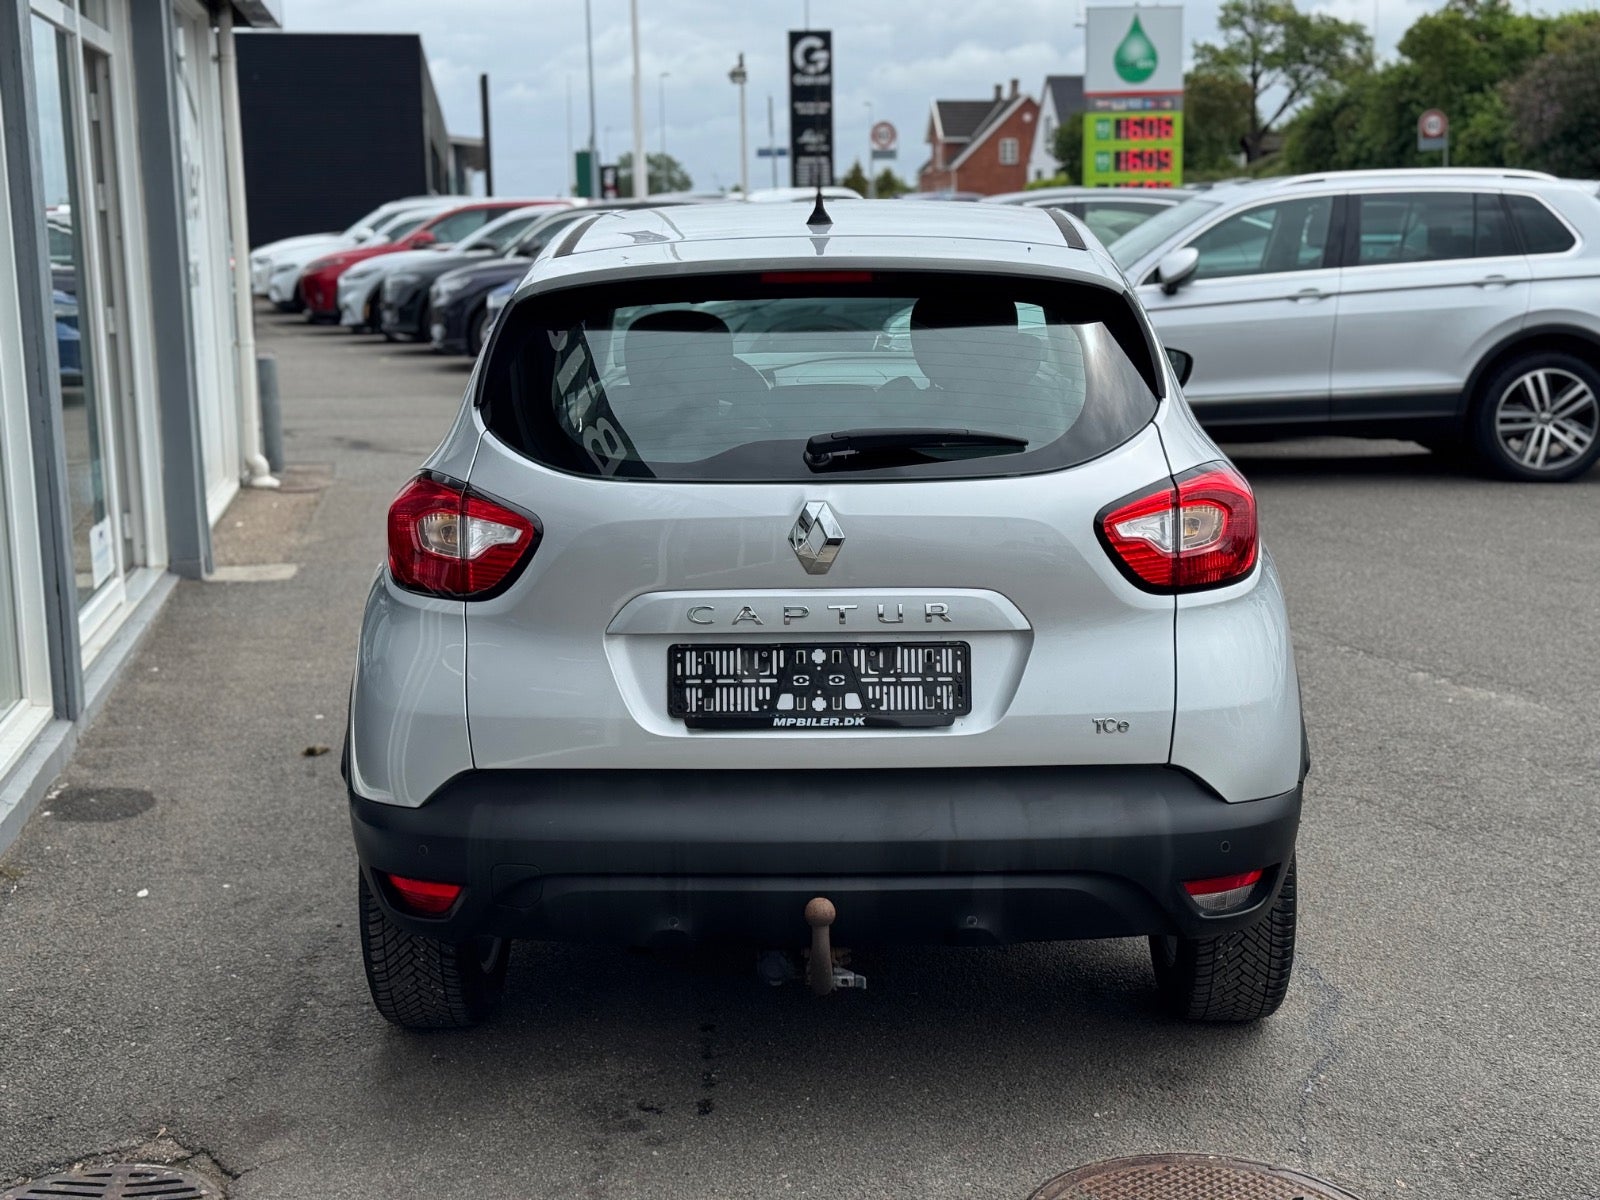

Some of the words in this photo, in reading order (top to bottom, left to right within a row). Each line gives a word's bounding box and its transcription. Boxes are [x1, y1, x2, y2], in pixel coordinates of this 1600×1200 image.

[686, 602, 954, 625] CAPTUR
[772, 716, 867, 728] MPBILER.DK
[1092, 717, 1130, 734] TCe
